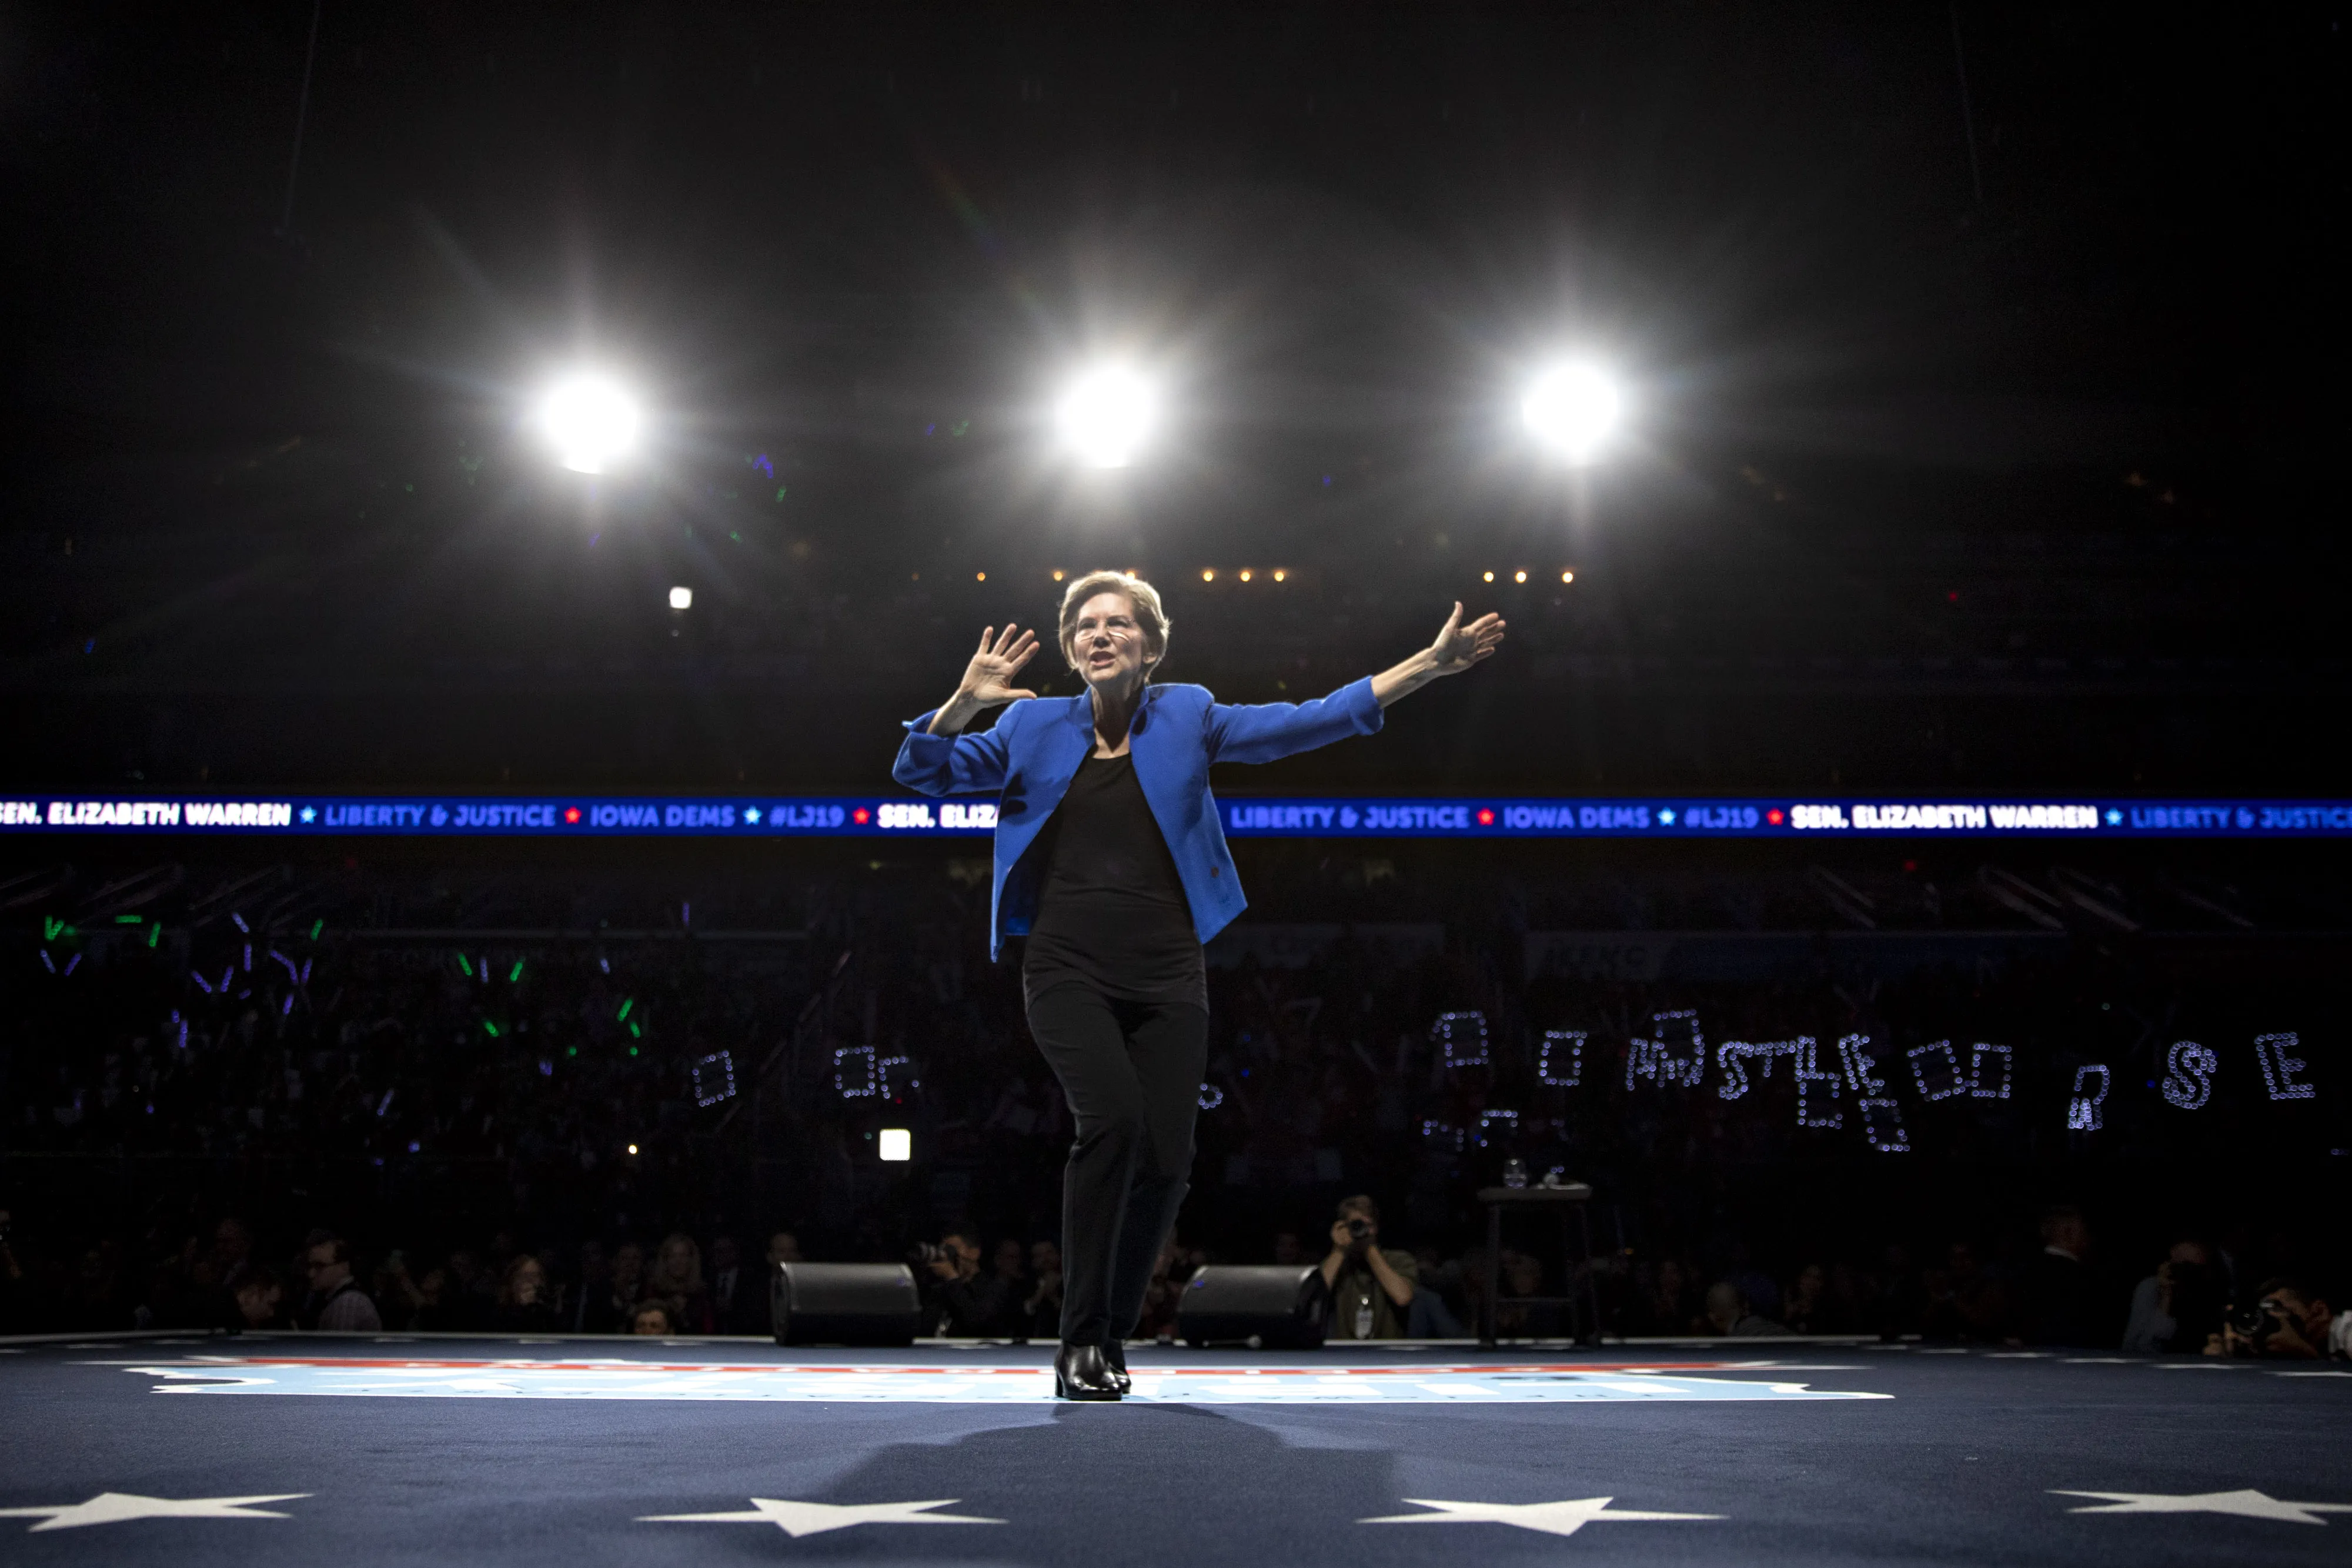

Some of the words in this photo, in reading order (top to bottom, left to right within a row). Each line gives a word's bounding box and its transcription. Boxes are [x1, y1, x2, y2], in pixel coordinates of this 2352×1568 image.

[47, 802, 180, 826] ELIZABETH
[185, 803, 292, 826] WARREN
[324, 805, 426, 826] LIBERTY
[453, 805, 557, 826] JUSTICE
[590, 805, 660, 827] IOWA
[665, 805, 736, 827] DEMS
[770, 805, 845, 827] #LJ19
[878, 804, 935, 828] SEN.
[940, 804, 998, 828] ELIZ
[1231, 806, 1335, 828] LIBERTY
[1363, 806, 1469, 828] JUSTICE
[1504, 807, 1575, 829] IOWA
[1579, 807, 1650, 829] DEMS
[1683, 807, 1760, 829] #LJ19
[1791, 804, 1849, 829] SEN.
[1852, 805, 1986, 828] ELIZABETH
[1989, 805, 2099, 829] WARREN
[2130, 806, 2232, 829] LIBERTY
[2260, 806, 2352, 829] JUSTIC
